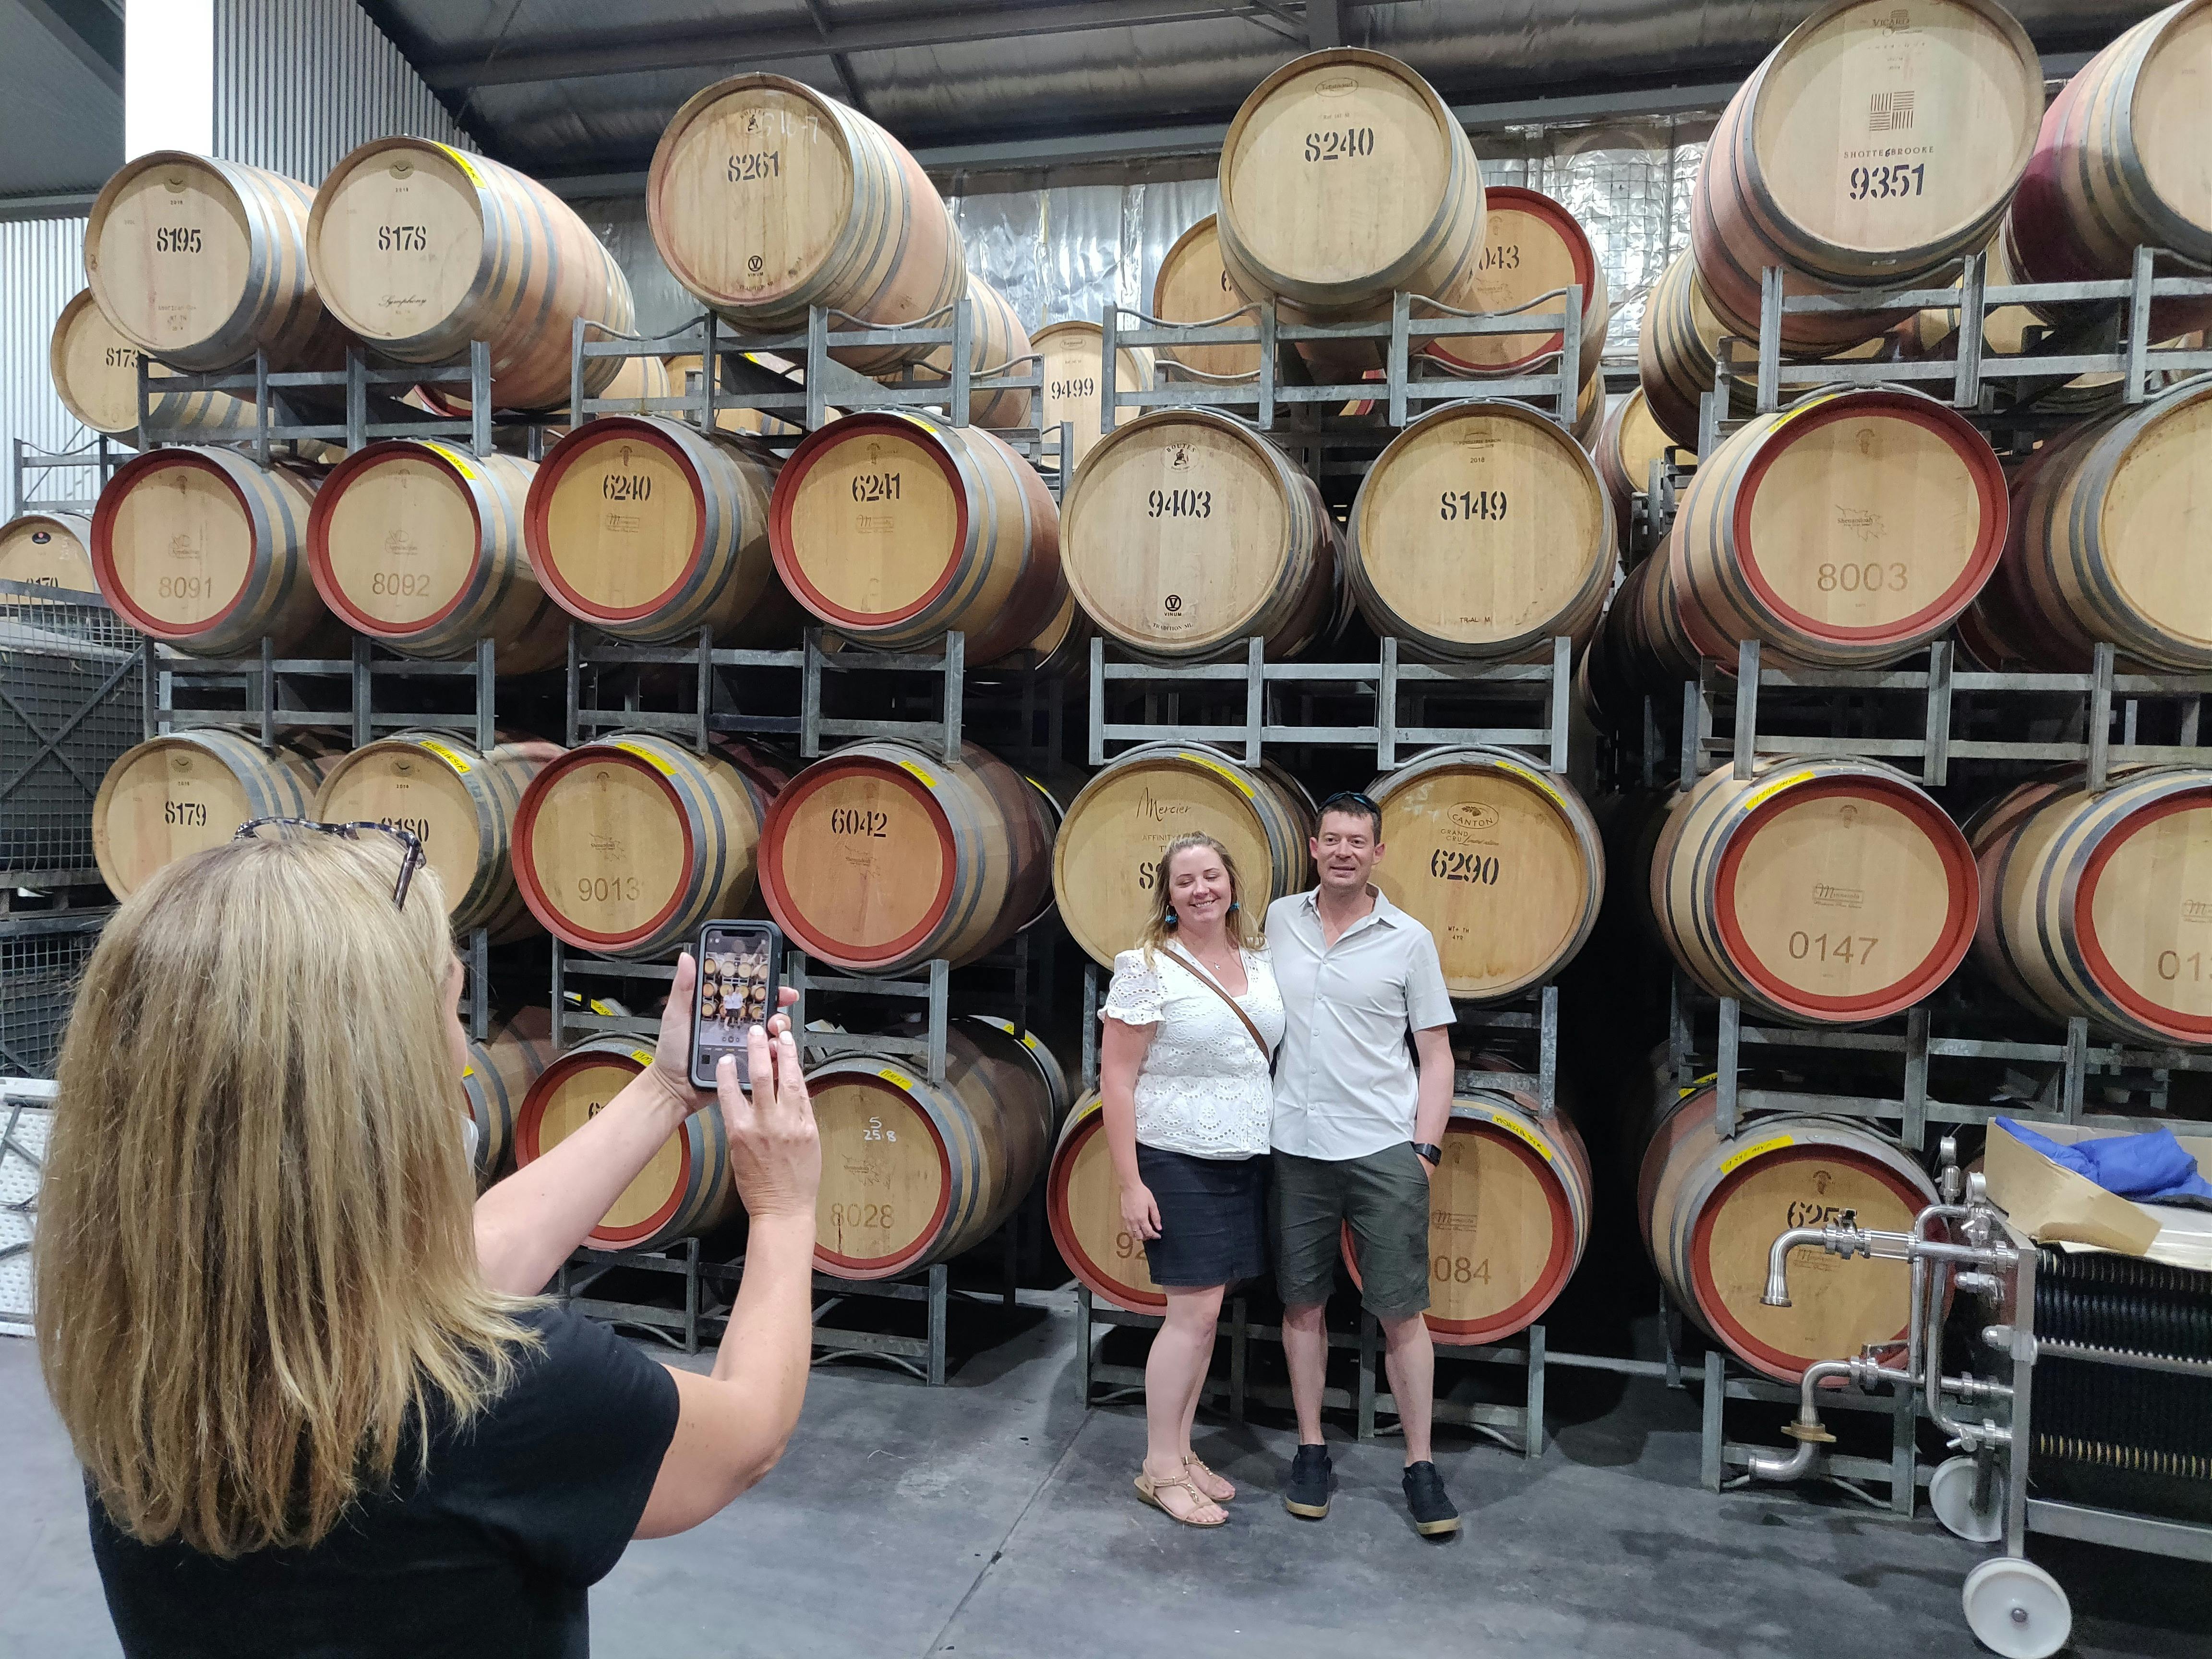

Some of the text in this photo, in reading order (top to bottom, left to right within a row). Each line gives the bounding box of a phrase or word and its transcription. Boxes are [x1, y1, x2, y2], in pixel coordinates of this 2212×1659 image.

[1305, 128, 1374, 162] S240
[728, 150, 779, 182] S261
[1850, 163, 1924, 200] 9351
[156, 227, 202, 253] S195
[379, 295, 426, 308] Symphony
[1051, 377, 1094, 399] 9499
[1166, 443, 1196, 452] BOUTES
[603, 474, 651, 501] 6240
[853, 472, 900, 502] 6241
[1148, 489, 1211, 518] 9403
[1441, 491, 1507, 521] S149
[158, 577, 212, 599] 8091
[373, 573, 430, 597] 8092
[1817, 563, 1908, 591] 8003
[1153, 623, 1182, 631] TRADITION
[165, 801, 206, 827] S179
[1137, 787, 1191, 821] Mercier
[831, 808, 888, 837] 6042
[1441, 829, 1468, 837] GRAND
[1453, 814, 1493, 826] CANTON
[1431, 849, 1500, 885] 6290
[578, 877, 640, 902] 9013
[1789, 931, 1879, 965] 0147
[2158, 950, 2212, 982] 01
[831, 1203, 895, 1229] 8028
[1788, 1201, 1839, 1229] 625
[1429, 1255, 1491, 1285] 084
